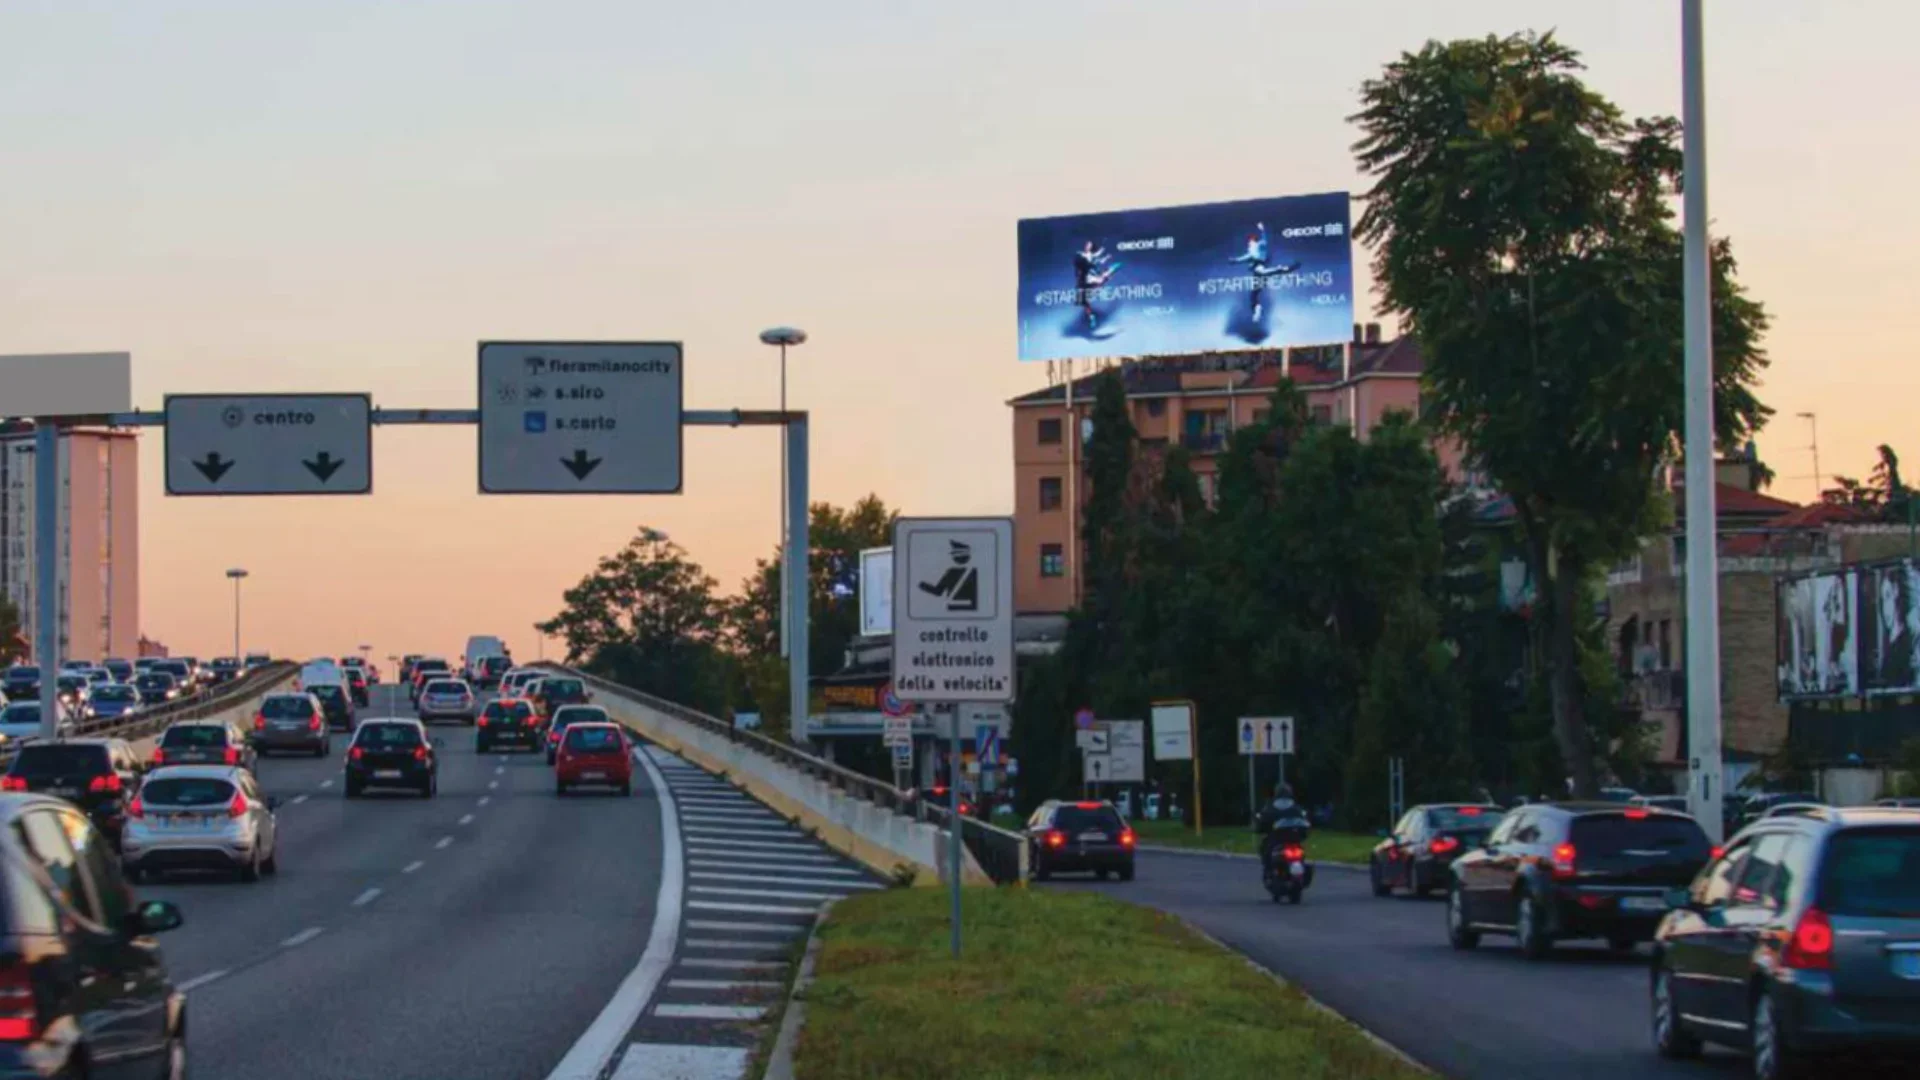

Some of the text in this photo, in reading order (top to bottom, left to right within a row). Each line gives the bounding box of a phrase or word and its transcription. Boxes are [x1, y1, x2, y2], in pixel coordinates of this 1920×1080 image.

[1198, 268, 1333, 294] #STARTBREATHING
[1035, 283, 1163, 306] #STARTBREATHING
[550, 358, 671, 374] fieramilanocity
[555, 384, 604, 400] s.siro
[253, 409, 315, 425] centro
[555, 415, 616, 430] s.carlo
[919, 626, 988, 642] controllo
[912, 651, 995, 667] elettronico
[898, 675, 935, 691] della
